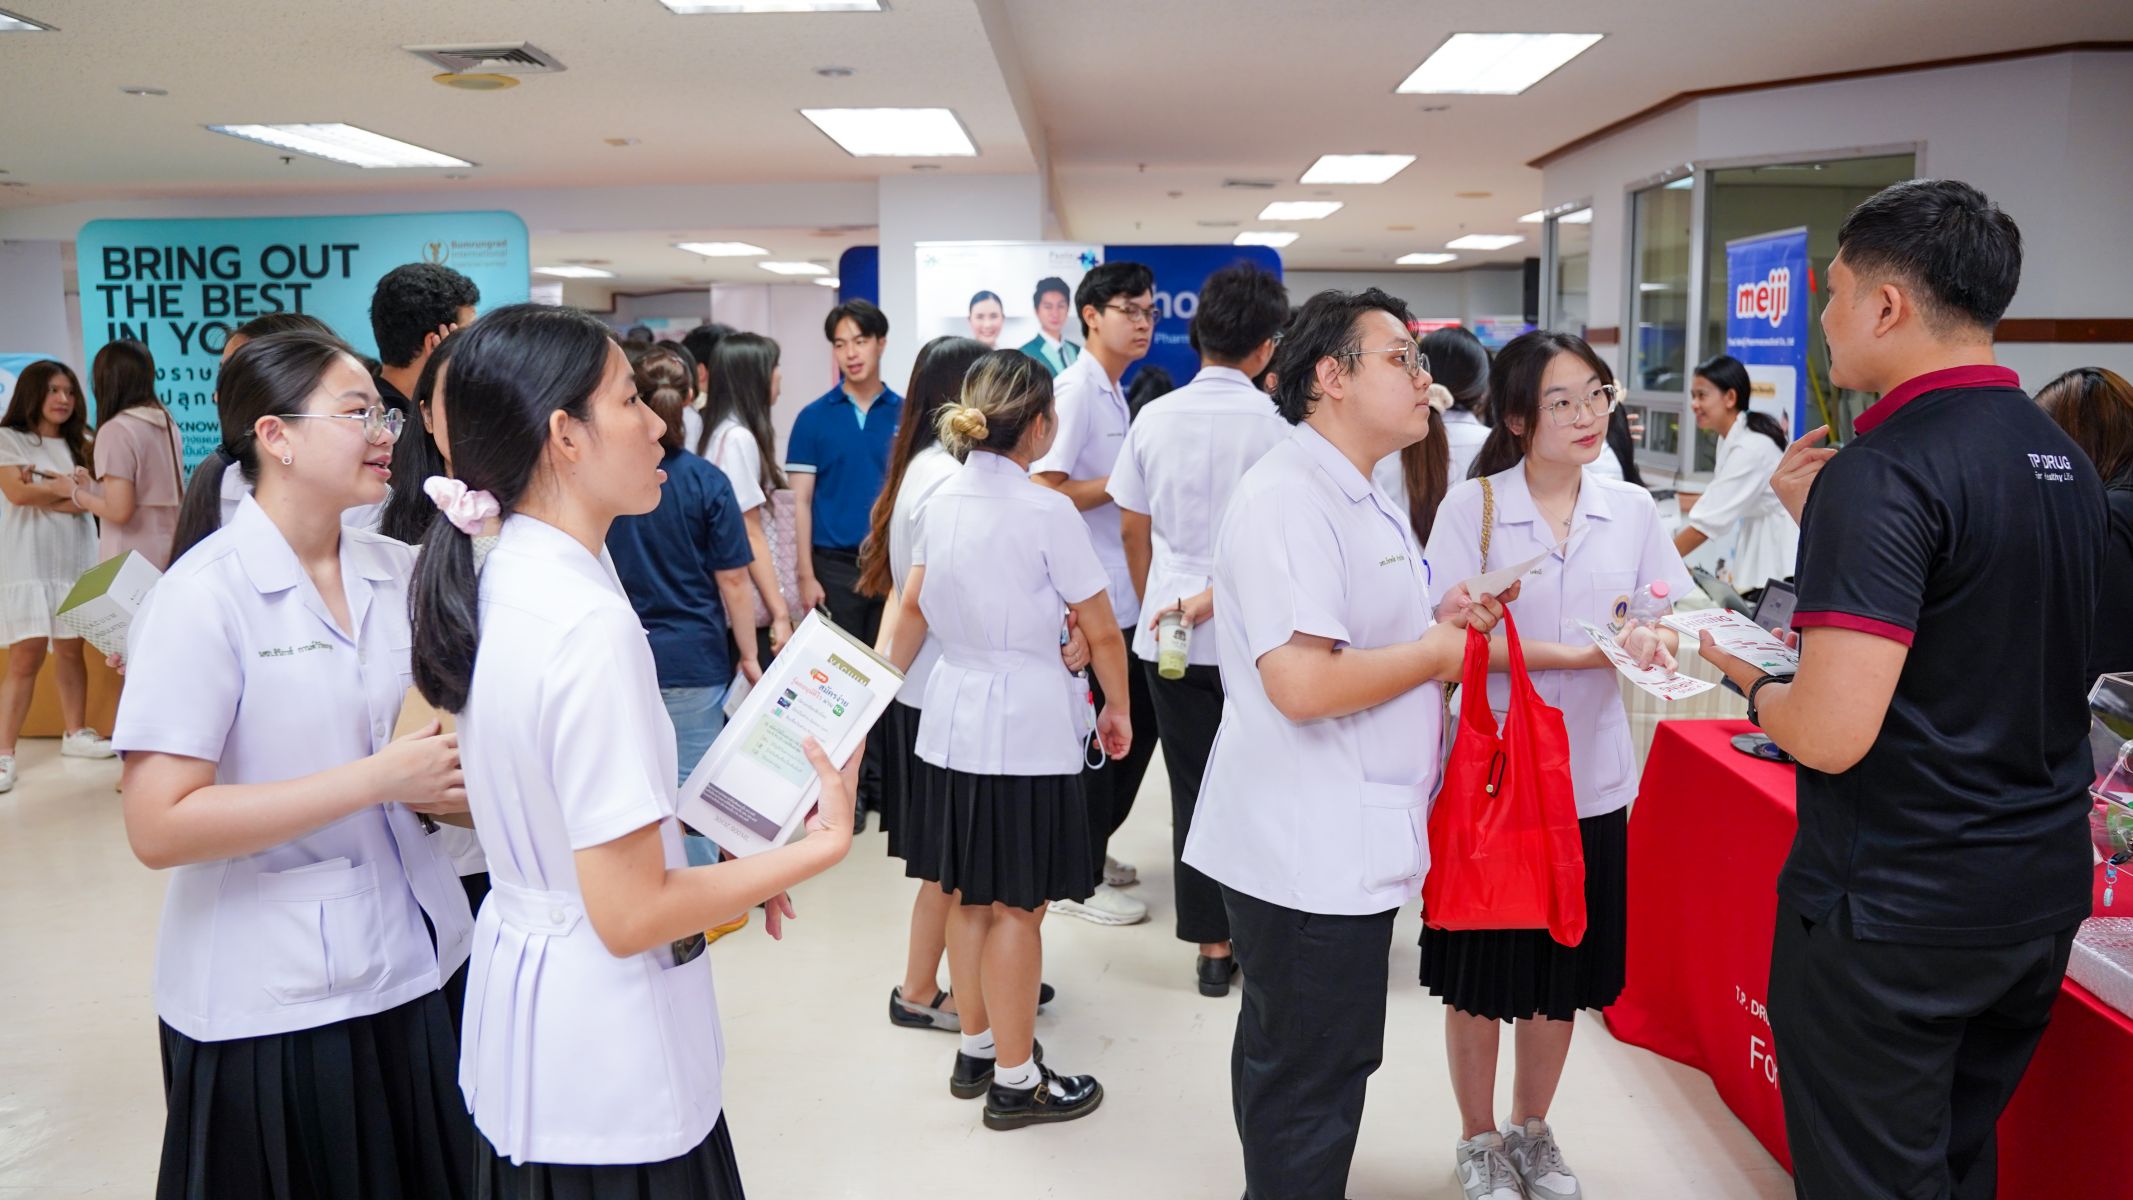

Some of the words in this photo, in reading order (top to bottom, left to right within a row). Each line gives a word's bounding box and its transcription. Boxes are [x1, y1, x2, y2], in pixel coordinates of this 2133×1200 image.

[103, 246, 242, 281] BRING
[260, 243, 359, 279] OUT
[96, 284, 184, 318] THE
[202, 283, 312, 318] BEST
[1738, 270, 1788, 325] meiji
[168, 320, 243, 356] YO
[2027, 453, 2041, 468] TP
[2040, 454, 2072, 470] DRUG
